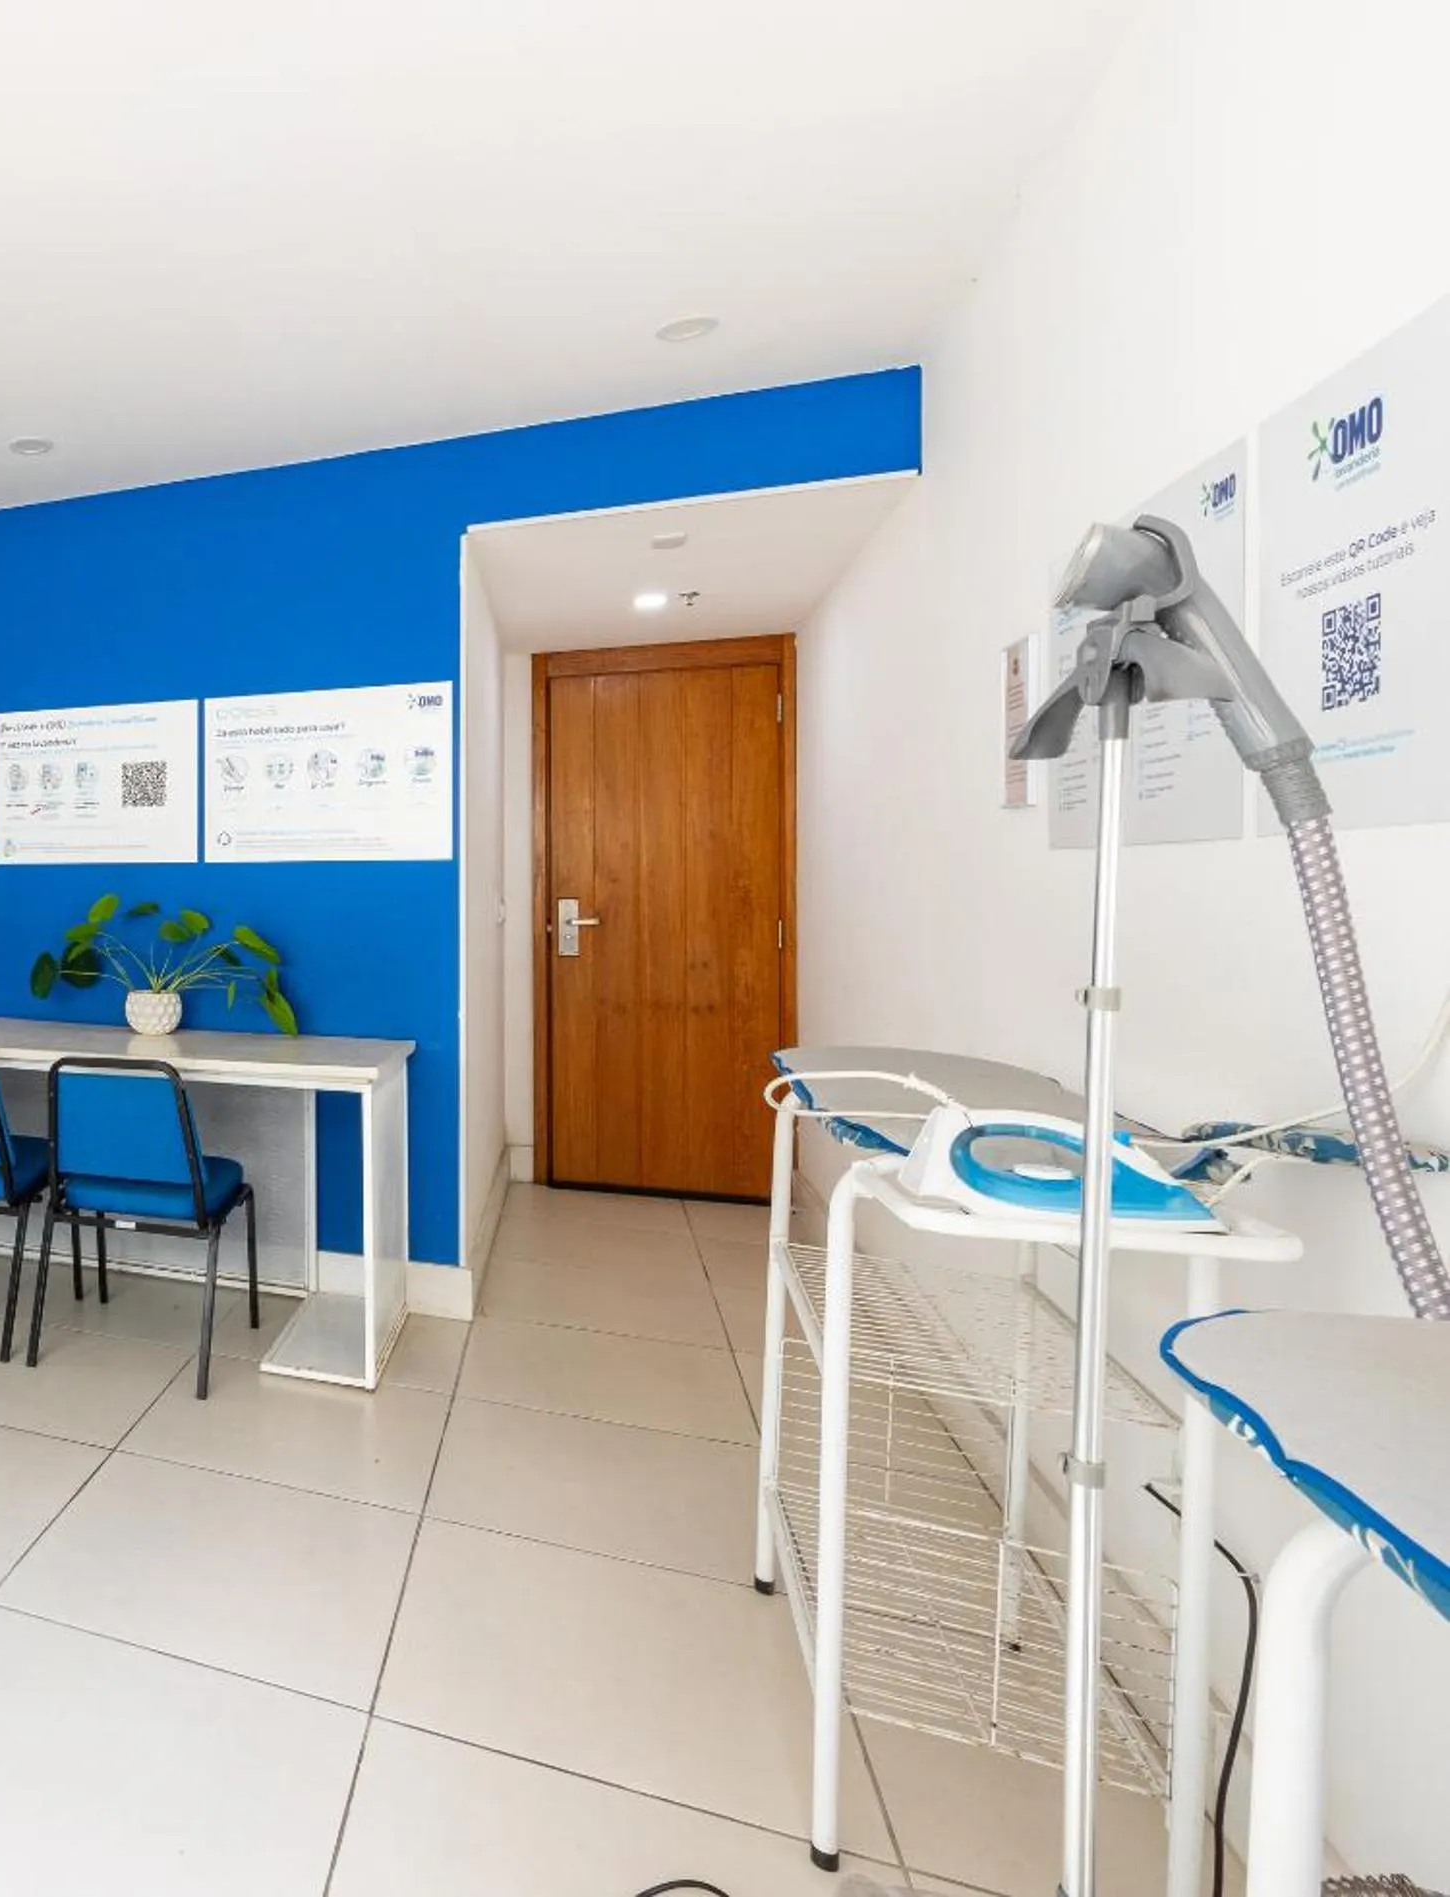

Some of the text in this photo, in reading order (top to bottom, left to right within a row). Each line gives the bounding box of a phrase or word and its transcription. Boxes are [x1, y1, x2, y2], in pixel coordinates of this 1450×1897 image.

[1330, 397, 1383, 464] OMO
[1212, 473, 1236, 507] OMO
[1349, 539, 1366, 558] QR
[1368, 526, 1397, 548] Code
